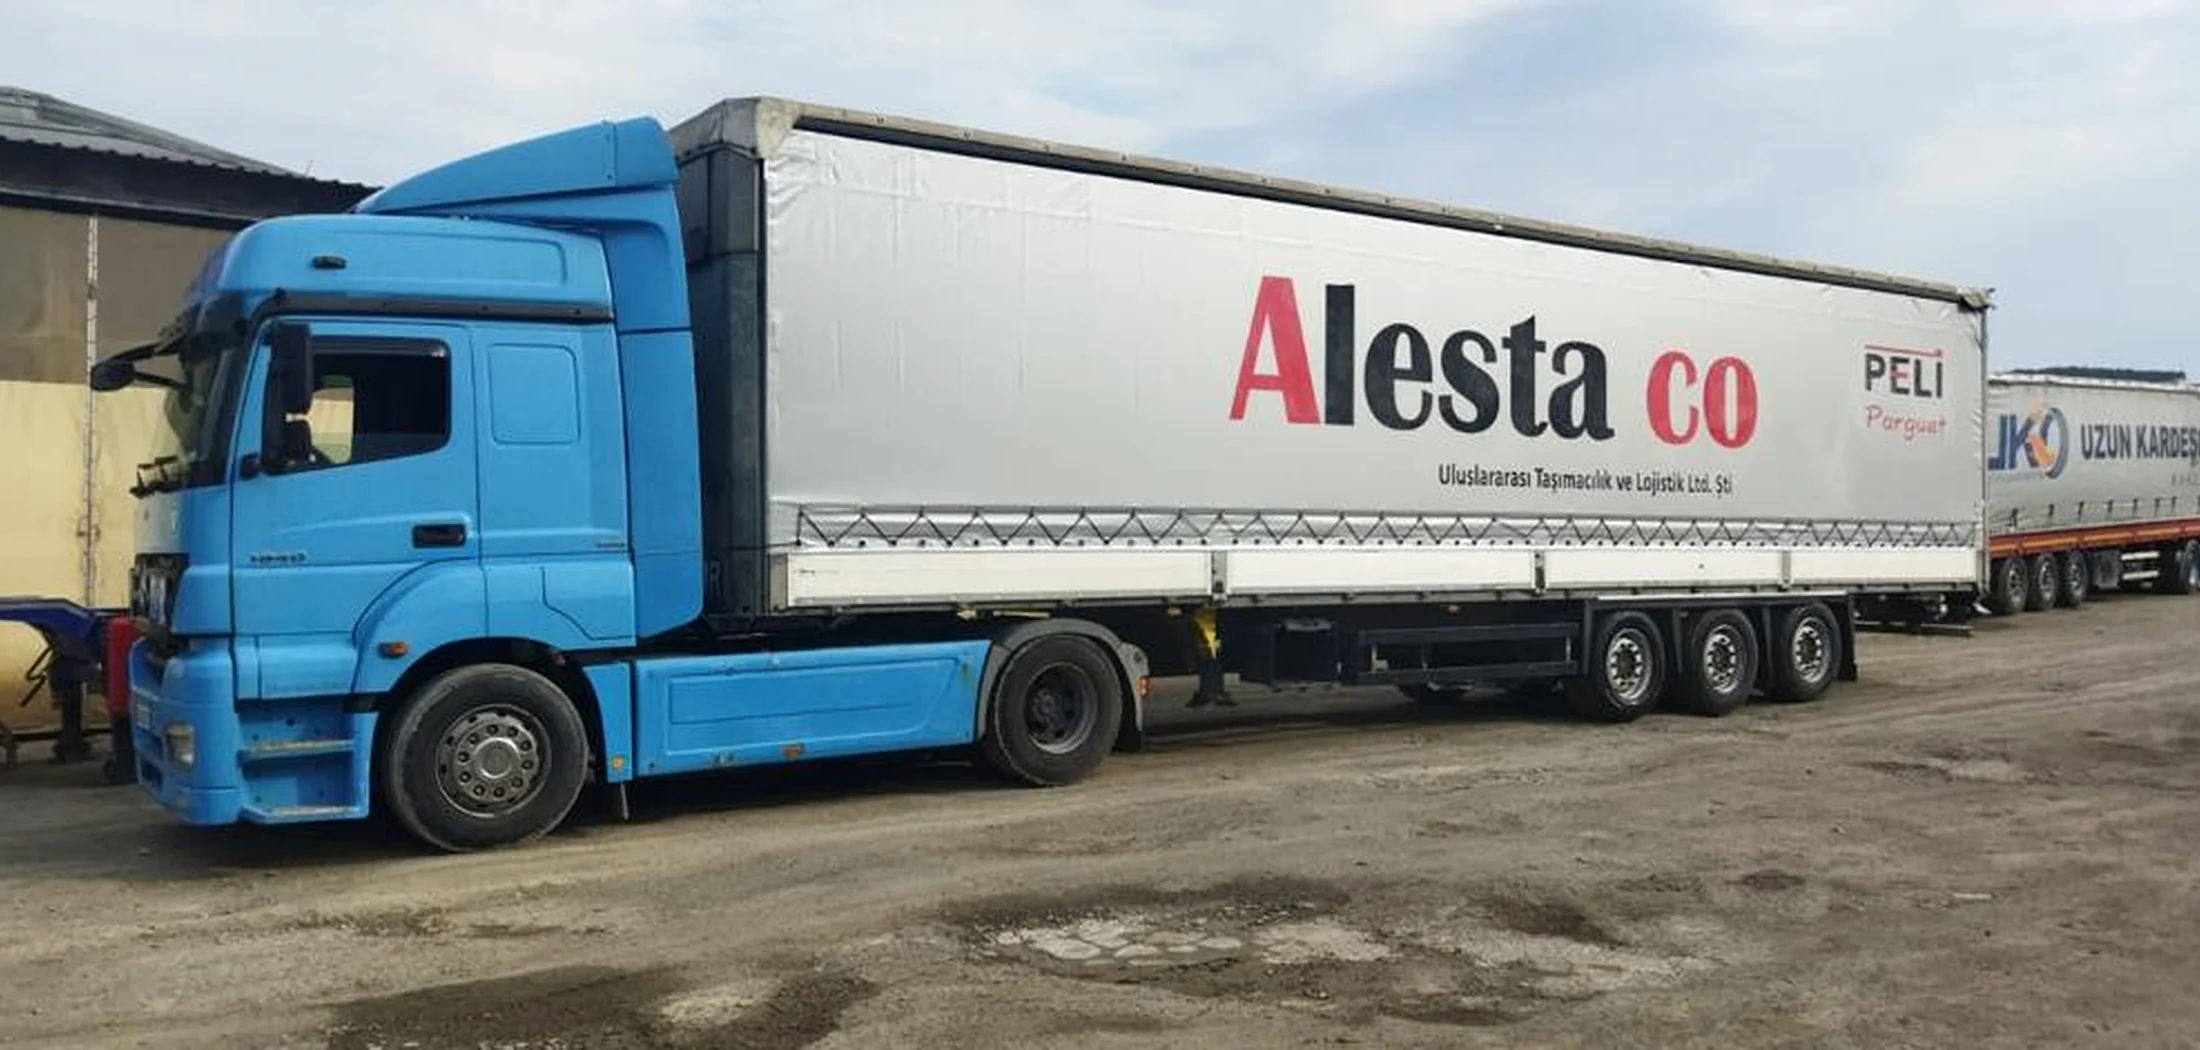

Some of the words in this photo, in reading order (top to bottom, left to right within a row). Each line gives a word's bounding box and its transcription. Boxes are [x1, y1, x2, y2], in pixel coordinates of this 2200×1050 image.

[1229, 275, 1616, 441] Alesta
[1646, 350, 1759, 450] co
[2081, 424, 2131, 460] UZUN
[2136, 425, 2200, 467] KARDEŞ
[1438, 463, 1532, 488] Uluslararası
[1615, 475, 1633, 491] ve
[1635, 470, 1685, 496] Lojistik
